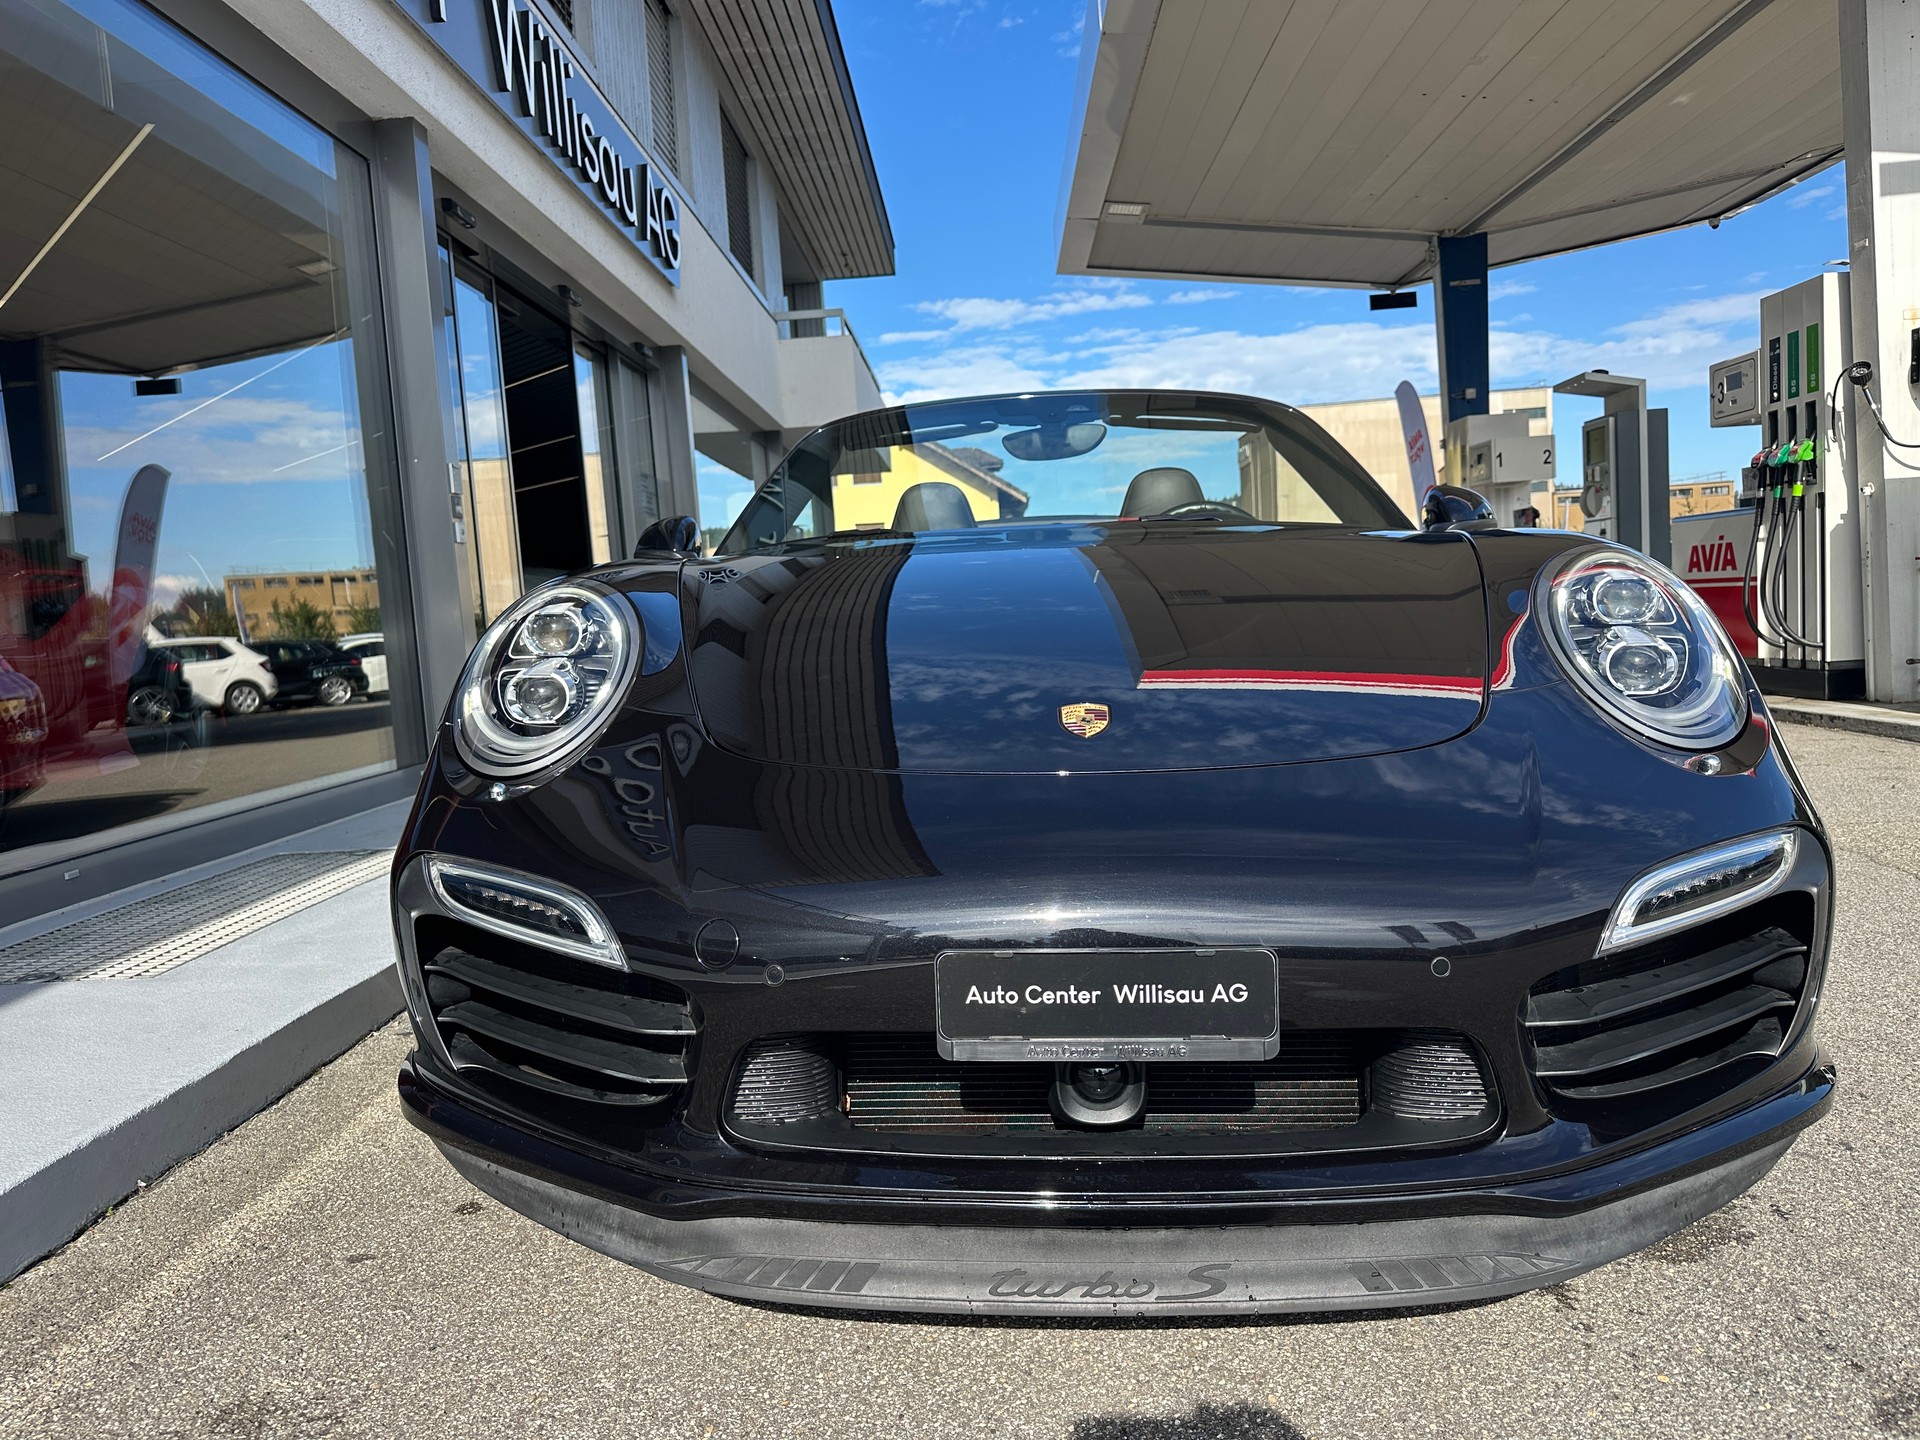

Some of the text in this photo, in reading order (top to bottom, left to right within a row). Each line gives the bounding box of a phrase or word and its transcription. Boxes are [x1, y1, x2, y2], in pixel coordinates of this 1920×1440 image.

[486, 0, 681, 269] Willisau AG
[1717, 381, 1725, 404] 3
[1496, 452, 1503, 468] 1
[1543, 449, 1552, 465] 2
[965, 983, 1248, 1005] Auto Center Willisau AG
[1027, 1044, 1188, 1058] Auto Center Willisau AG
[988, 1263, 1232, 1301] turbo S
